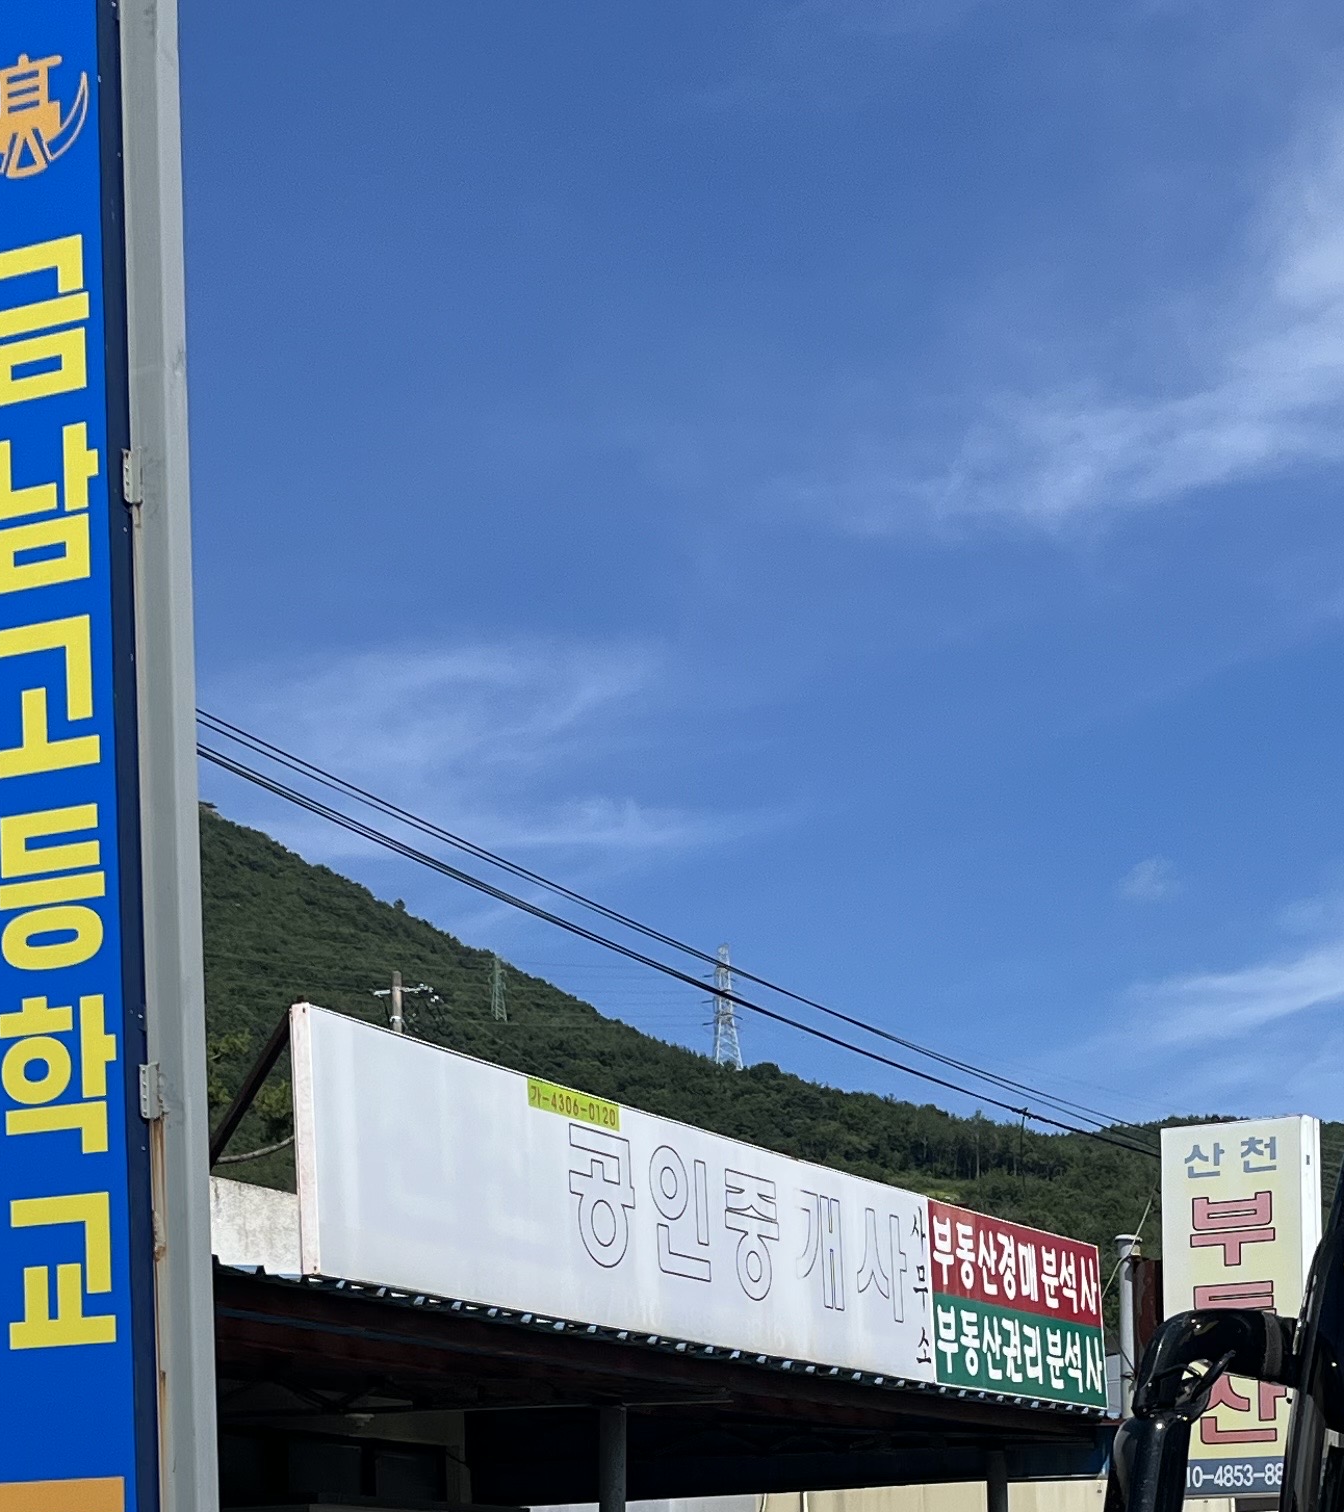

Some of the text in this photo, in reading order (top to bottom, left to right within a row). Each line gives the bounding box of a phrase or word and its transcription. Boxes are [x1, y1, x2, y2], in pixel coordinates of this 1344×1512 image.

[568, 1122, 907, 1323] 공인중개사
[1184, 1136, 1278, 1178] 산천
[910, 1206, 931, 1364] 사무소
[1190, 1191, 1288, 1444] 부산
[1186, 1463, 1284, 1488] 10-4853-88
